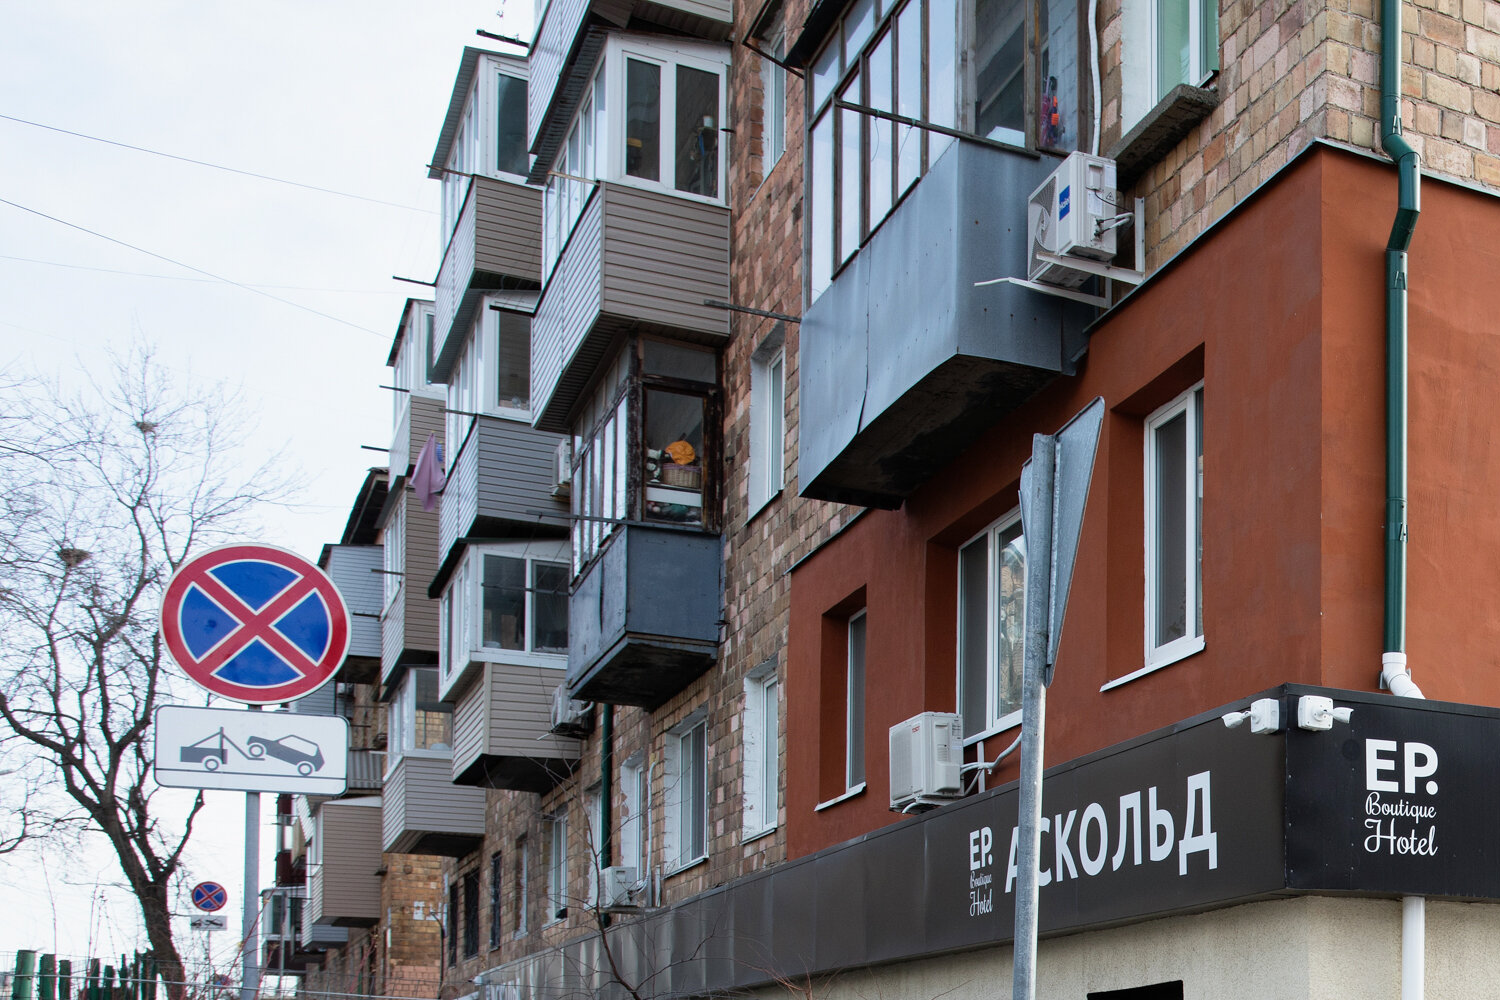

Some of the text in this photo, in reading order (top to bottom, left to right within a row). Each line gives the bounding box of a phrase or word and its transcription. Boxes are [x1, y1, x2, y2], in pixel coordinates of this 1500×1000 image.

[1365, 791, 1437, 824] Boutique
[1364, 818, 1439, 856] Hotel
[969, 870, 992, 890] Boutique
[969, 888, 994, 917] Hotel
